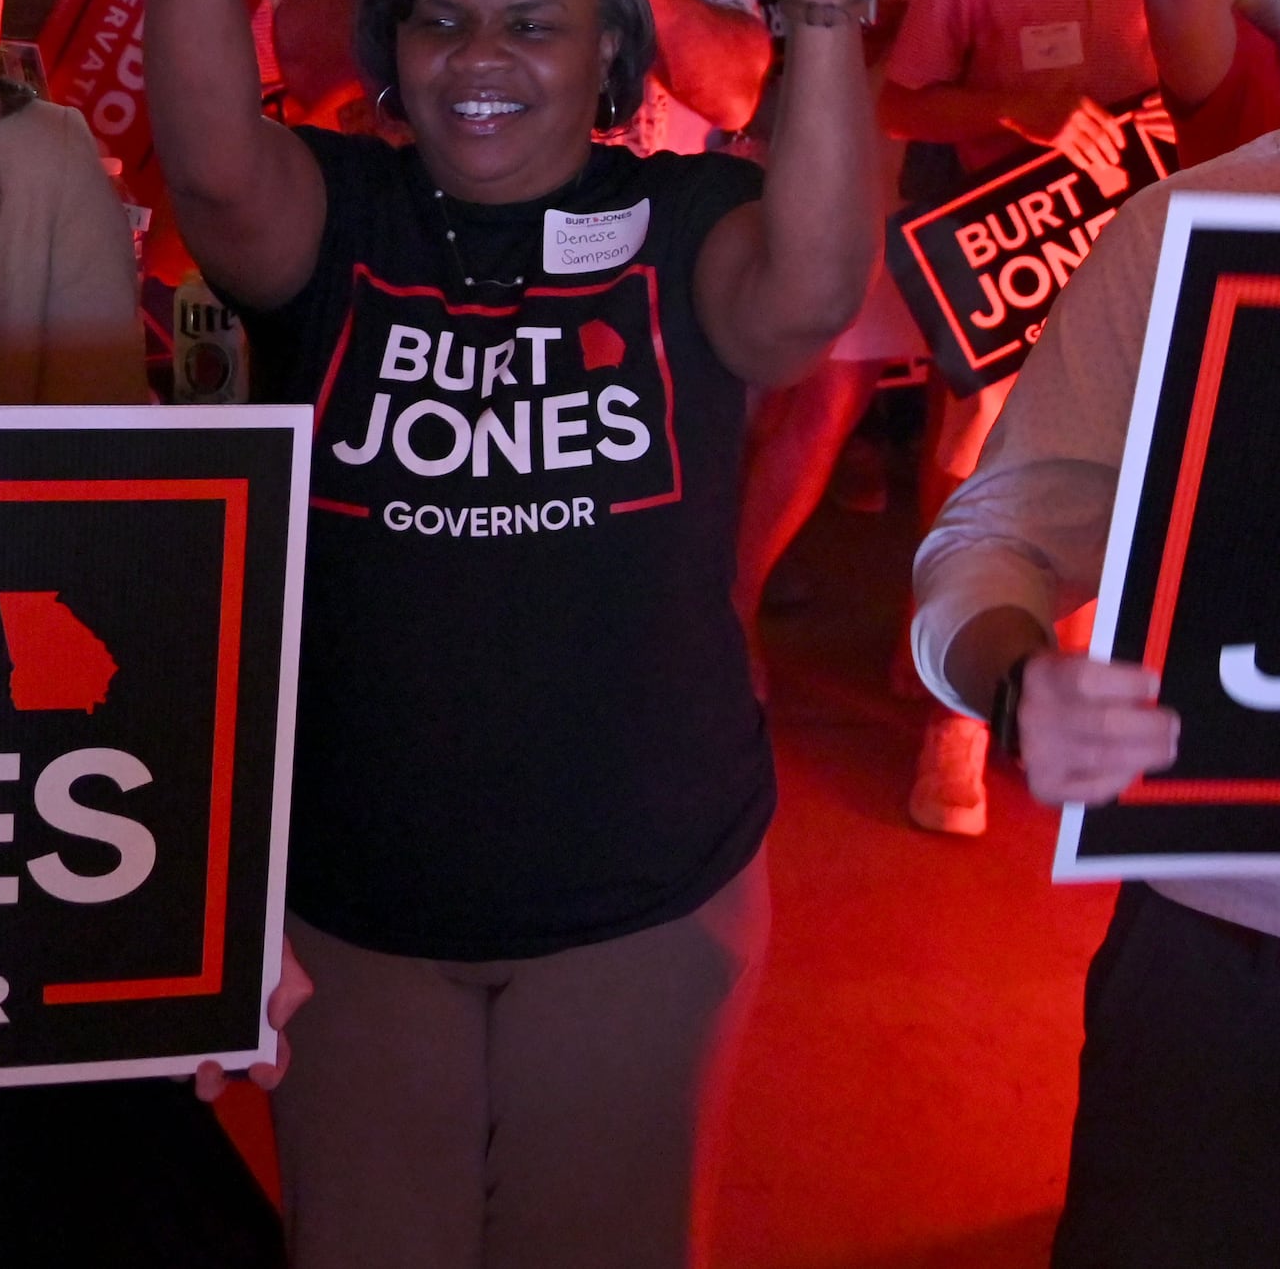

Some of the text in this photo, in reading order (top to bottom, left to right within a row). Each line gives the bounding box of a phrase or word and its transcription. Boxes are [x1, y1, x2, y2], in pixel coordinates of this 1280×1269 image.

[565, 216, 590, 225] BURT
[600, 210, 632, 223] JONES
[954, 172, 1084, 270] BURT
[561, 243, 630, 266] Sampson
[378, 323, 562, 399] BURT
[332, 384, 651, 478] JONES
[383, 496, 596, 538] GOVERNOR
